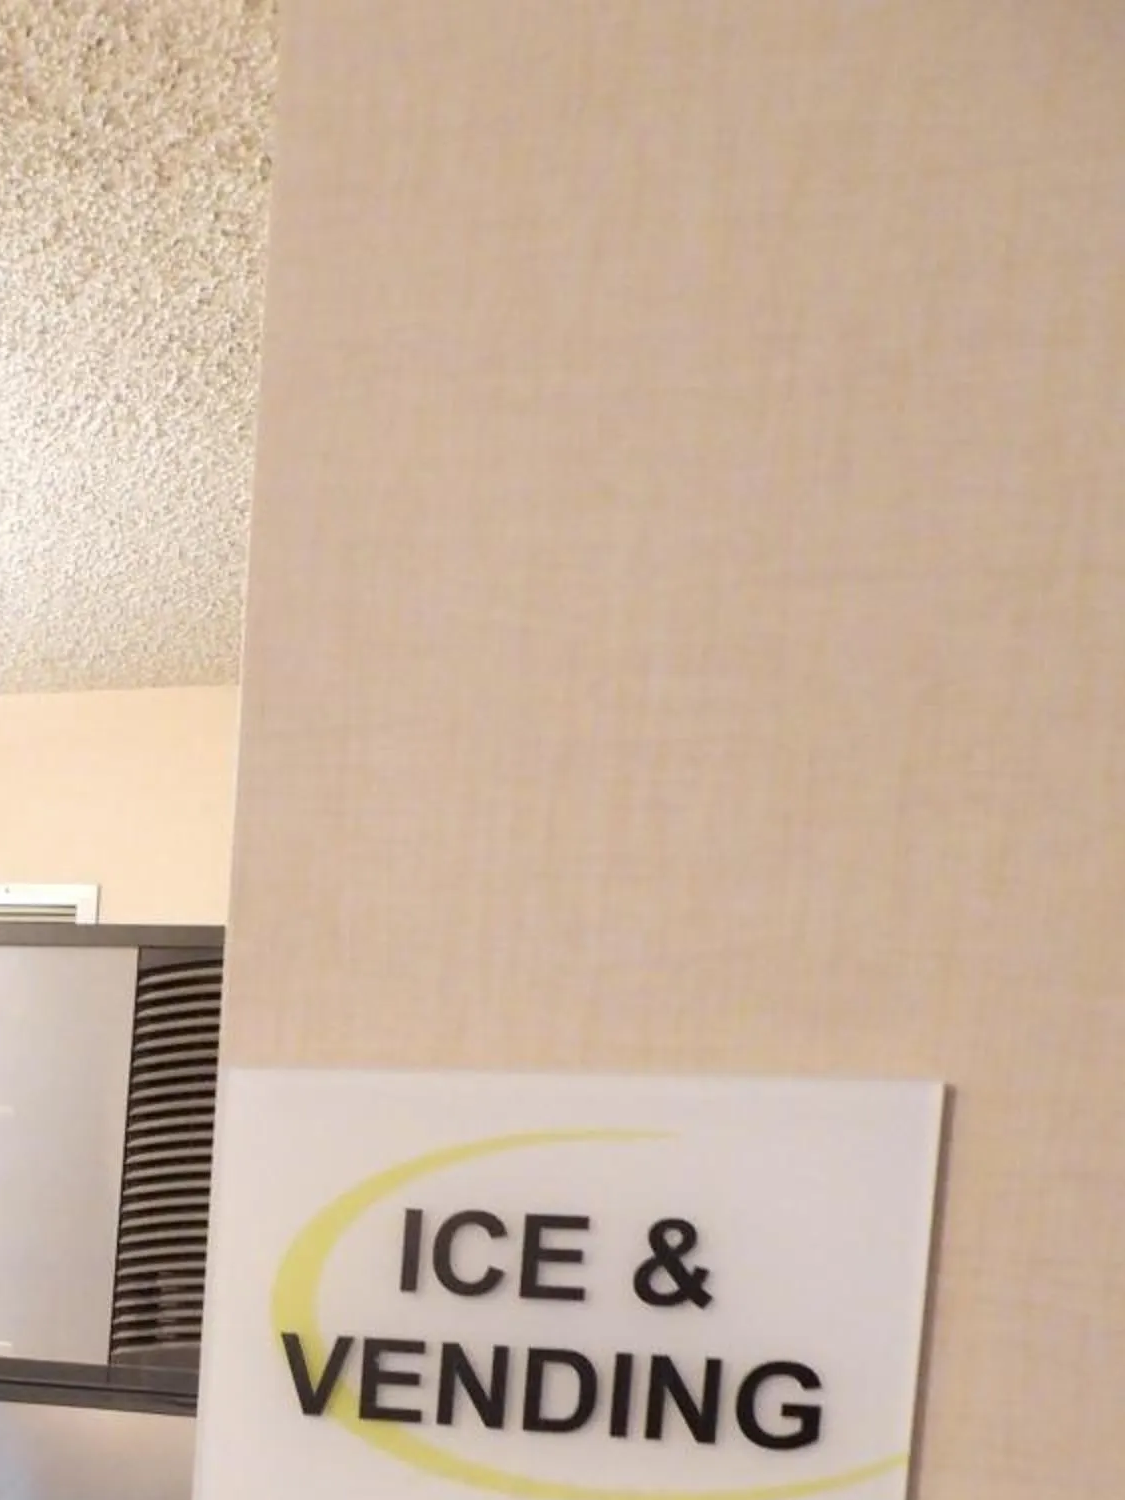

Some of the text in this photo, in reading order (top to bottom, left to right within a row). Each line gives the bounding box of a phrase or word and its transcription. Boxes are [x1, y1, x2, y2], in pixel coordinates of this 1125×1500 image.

[400, 1208, 713, 1310] ICE &
[281, 1332, 822, 1450] VENDING
